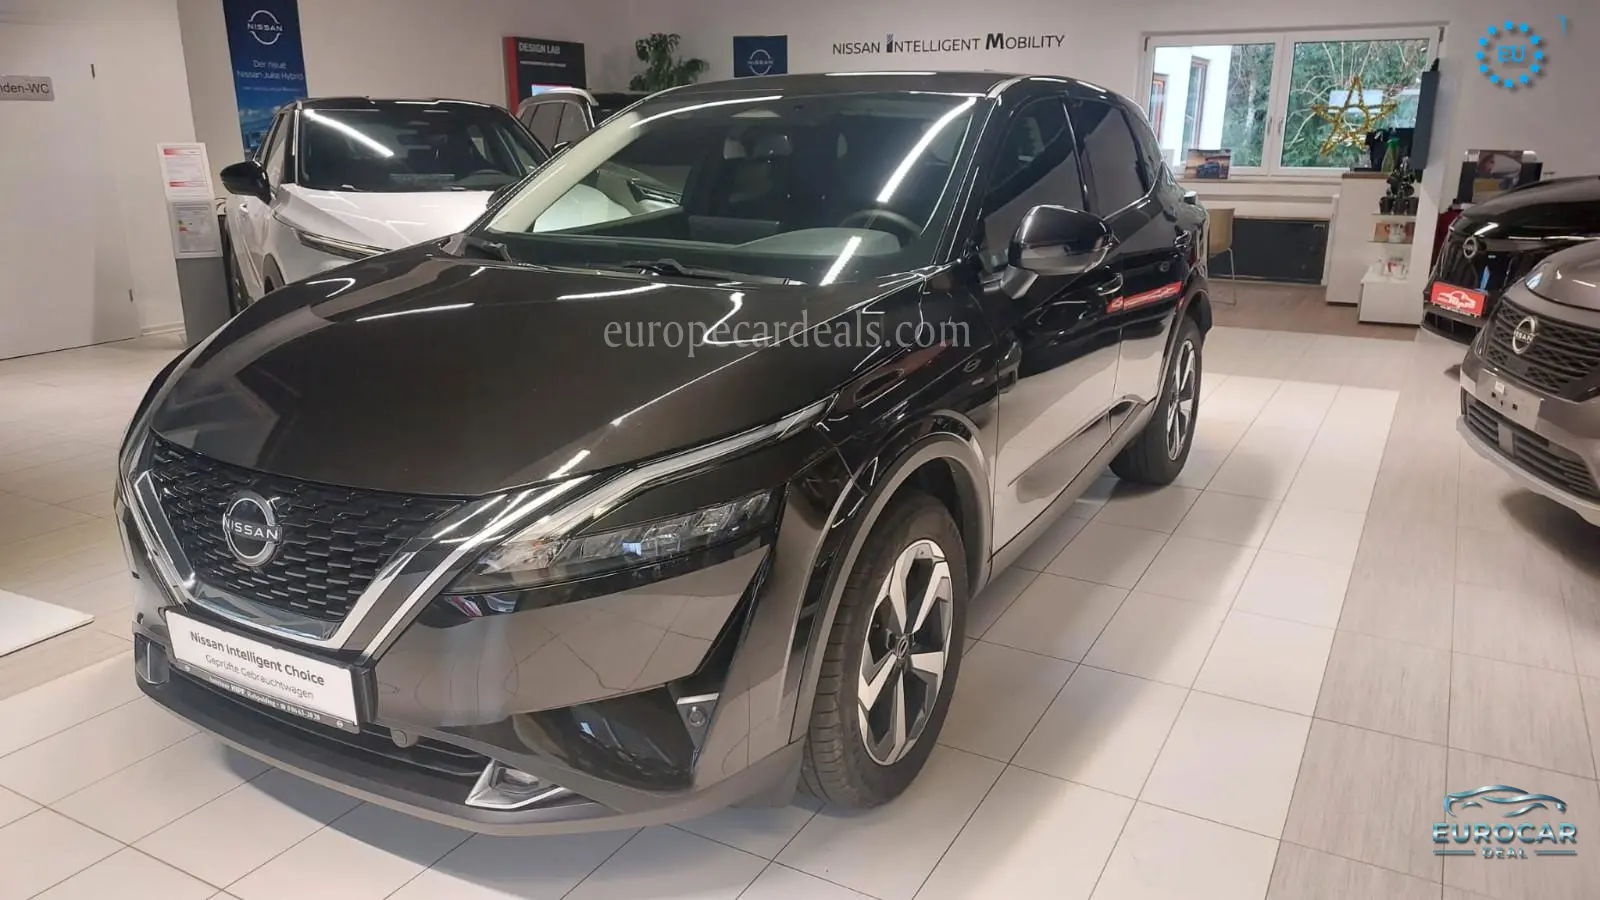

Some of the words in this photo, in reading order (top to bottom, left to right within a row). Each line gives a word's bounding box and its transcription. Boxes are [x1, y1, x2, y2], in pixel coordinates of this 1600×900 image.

[247, 23, 283, 32] NISSAN
[518, 41, 546, 54] DESIGN
[547, 44, 561, 55] LAB
[832, 42, 880, 55] NISSAN
[886, 34, 981, 53] INTELLIGENT
[985, 33, 1065, 50] MOBILITY
[223, 516, 279, 540] NISSAN
[190, 631, 225, 653] Nissan
[226, 644, 283, 676] Intelligent
[284, 665, 325, 687] Choice
[241, 667, 314, 700] Gebrauchtwagen
